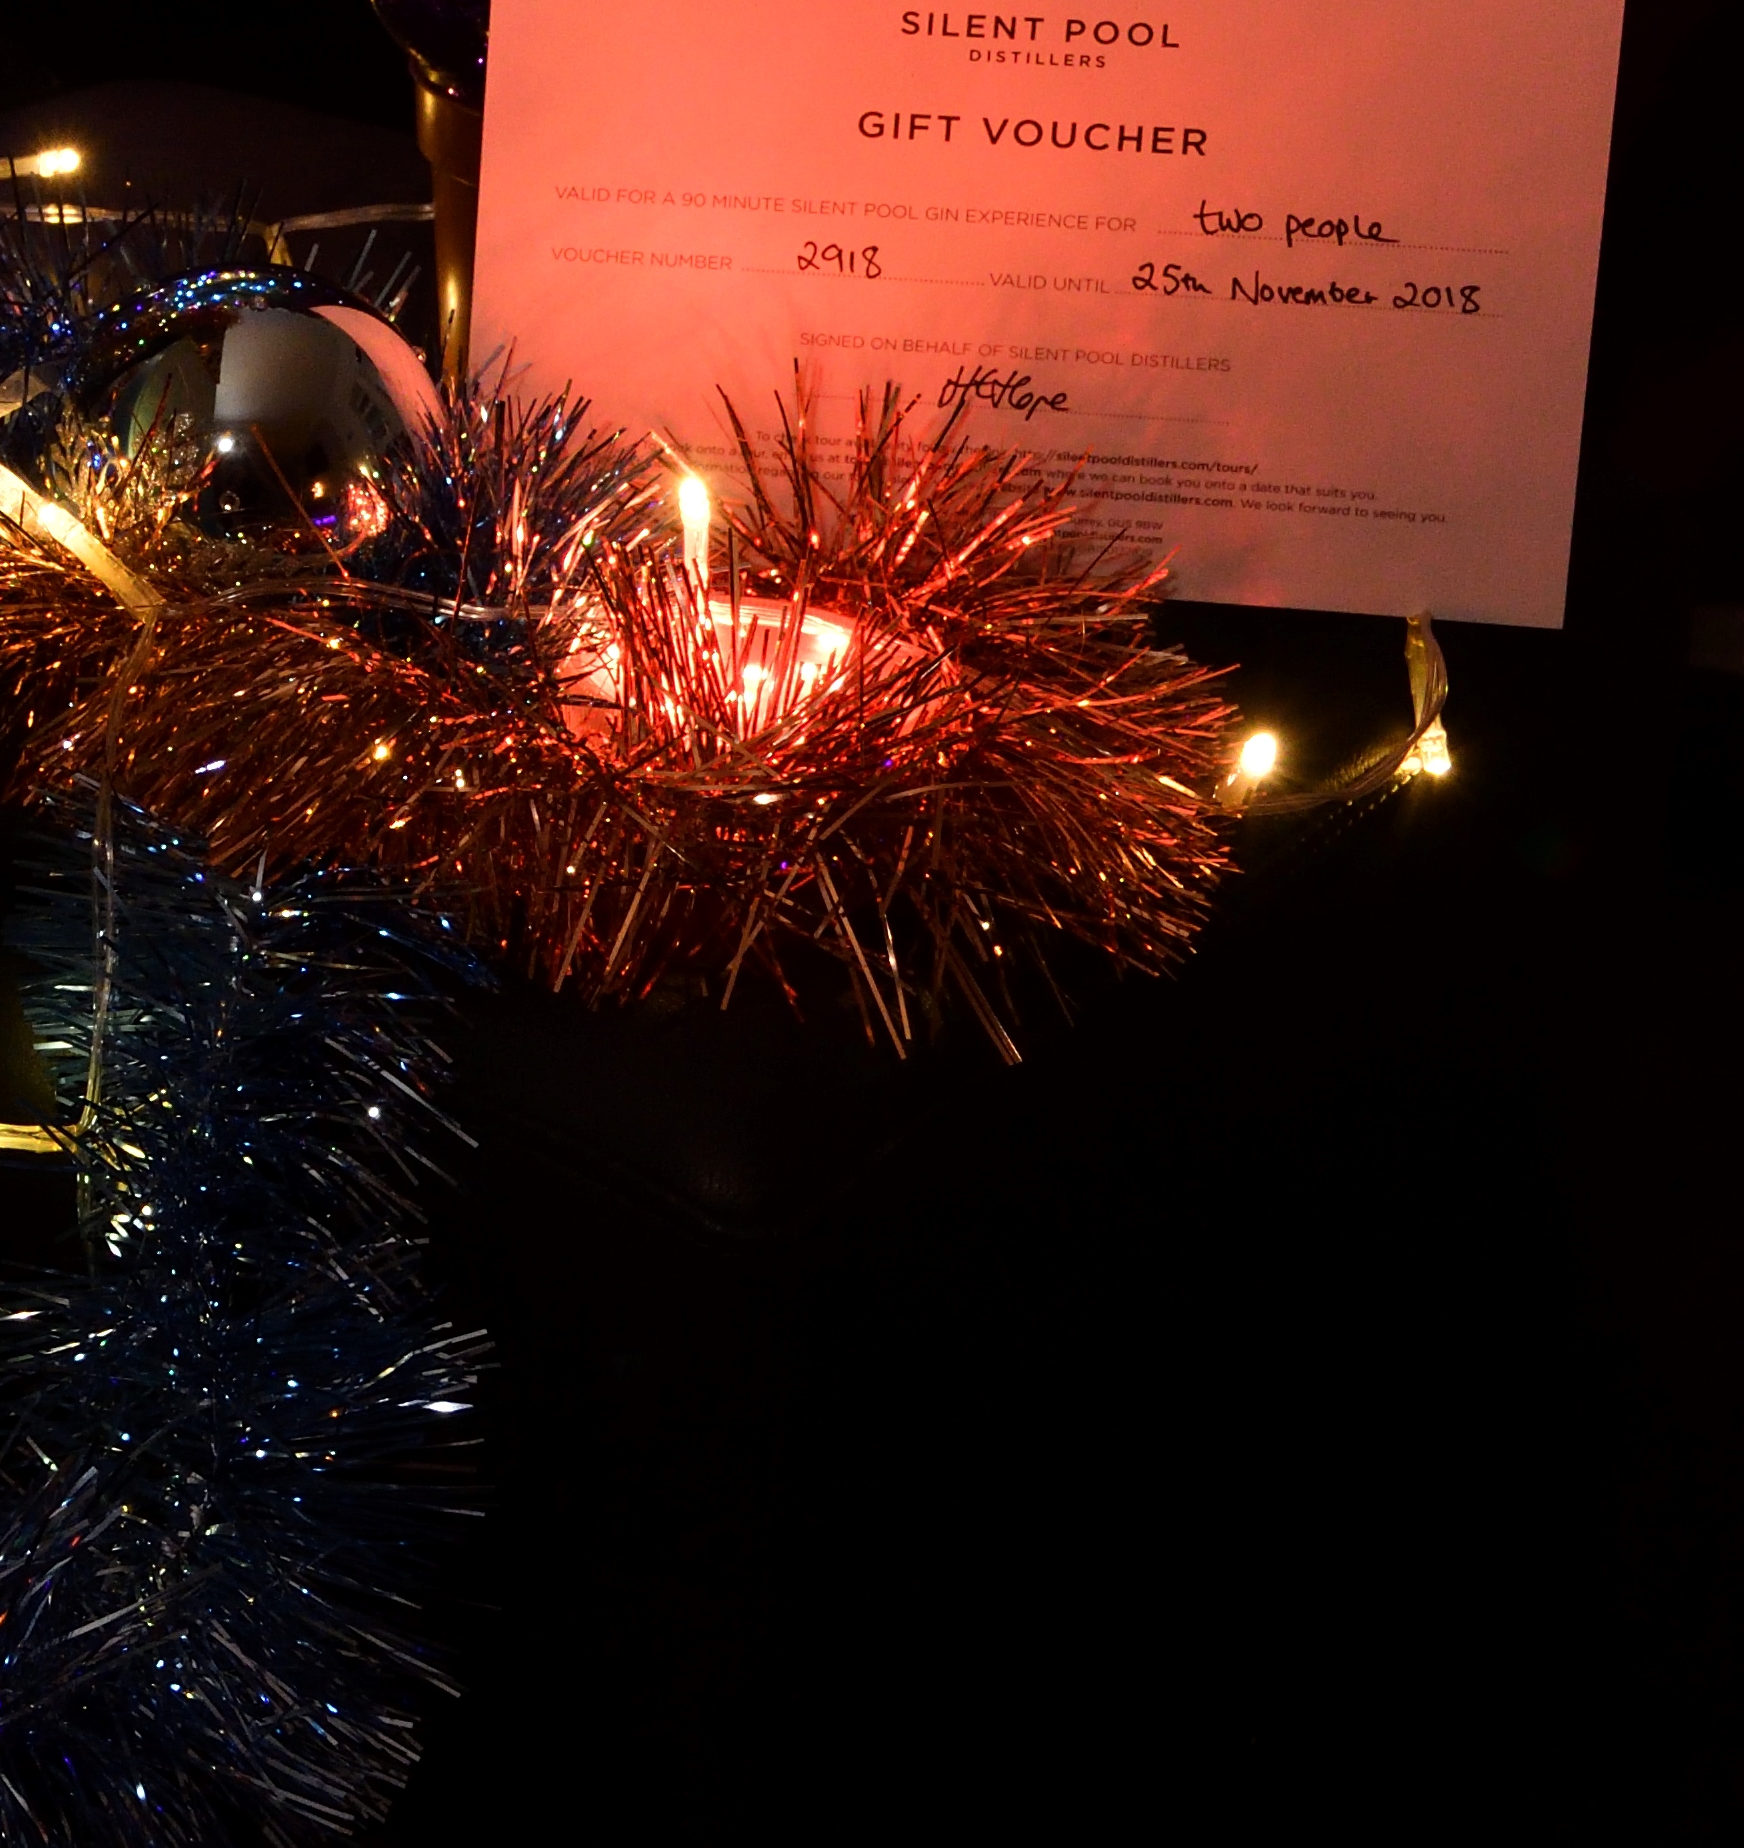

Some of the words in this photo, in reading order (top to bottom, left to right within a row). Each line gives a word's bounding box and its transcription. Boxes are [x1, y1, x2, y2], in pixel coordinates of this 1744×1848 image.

[901, 11, 1045, 41] SILENT
[1065, 19, 1180, 48] POOL
[969, 49, 1105, 68] DISTILLERS
[858, 111, 961, 142] GIFT
[982, 117, 1207, 156] VOUCHER
[556, 187, 610, 201] VALID
[617, 189, 655, 203] FOR
[664, 193, 674, 204] A
[683, 193, 705, 206] 90
[713, 195, 783, 211] MINUTE
[792, 199, 856, 214] SILENT
[865, 203, 917, 219] POOL
[926, 207, 958, 221] GIN
[966, 209, 1088, 229] EXPERIENCE
[1096, 216, 1136, 231] FOR
[1193, 200, 1263, 235] two
[1286, 214, 1399, 247] people
[554, 248, 641, 263] VOUCHER
[651, 253, 731, 269] NUMBER
[798, 241, 881, 279] 2918
[990, 273, 1046, 289] VALID
[1054, 277, 1109, 293] UNTIL
[1231, 271, 1378, 305] November
[1393, 282, 1480, 314] 2018
[801, 332, 864, 348] SIGNED
[871, 338, 896, 350] ON
[903, 339, 969, 355] BEHALF
[979, 344, 1002, 356] OF
[1009, 346, 1069, 361] SILENT
[1075, 350, 1123, 365] POOL
[1131, 353, 1231, 372] DISTILLERS
